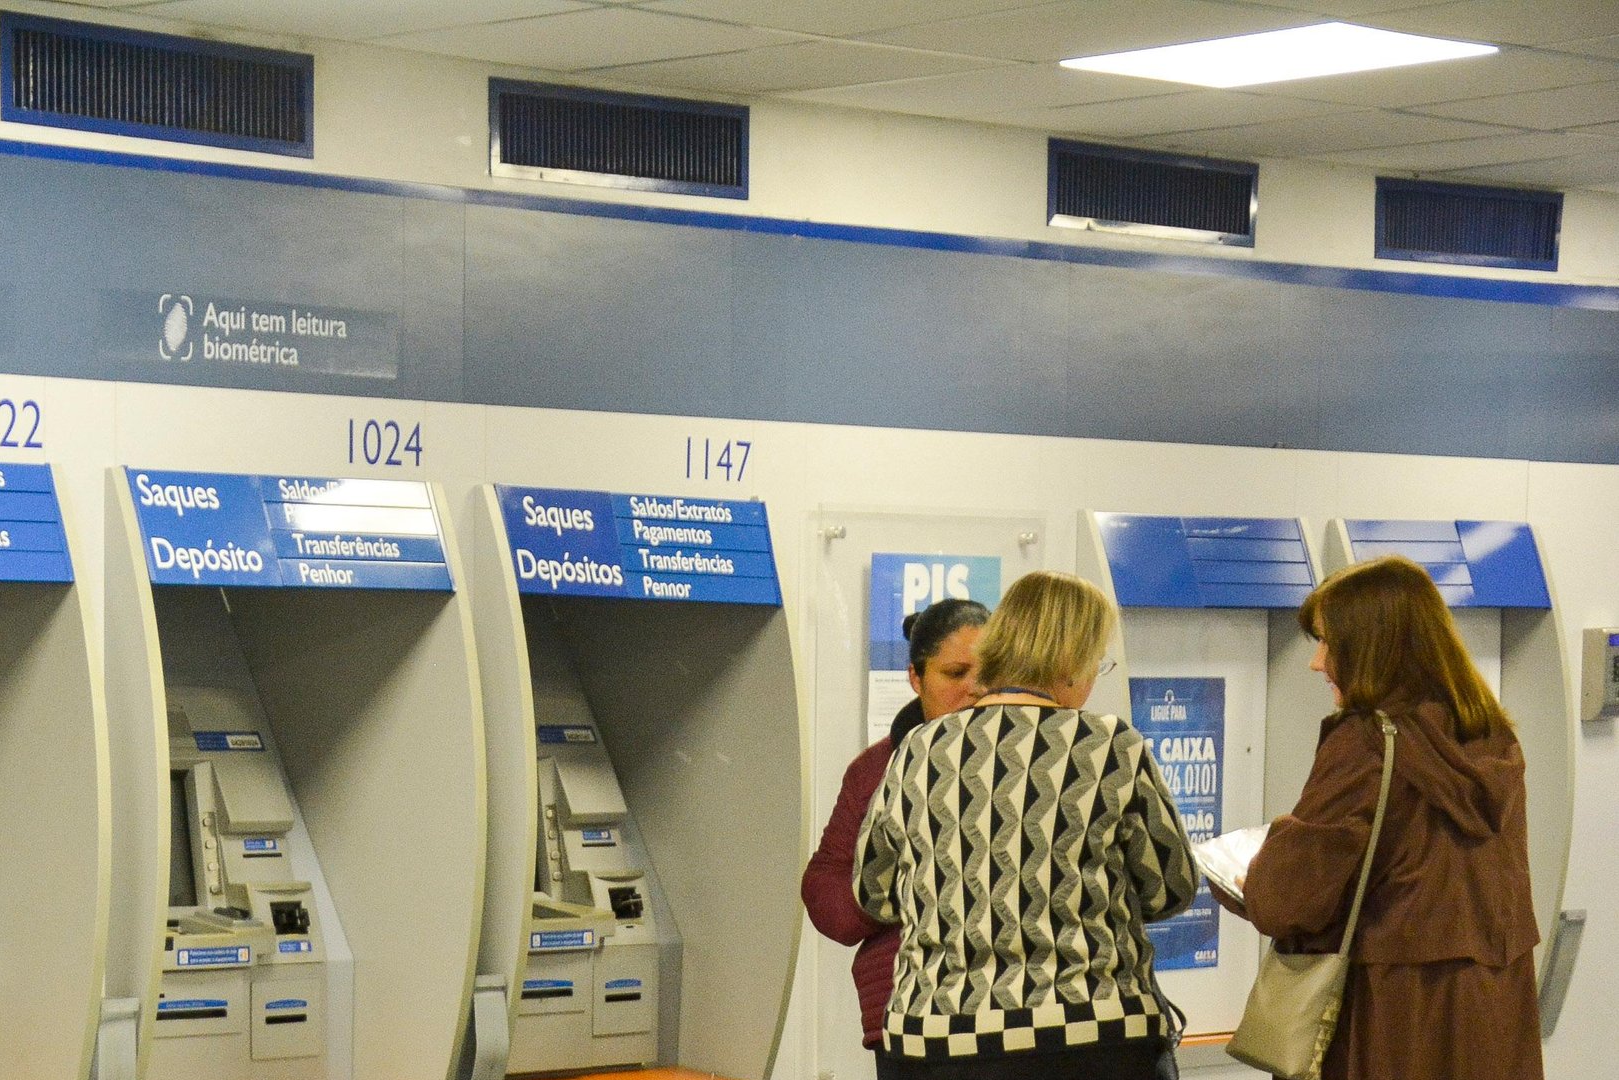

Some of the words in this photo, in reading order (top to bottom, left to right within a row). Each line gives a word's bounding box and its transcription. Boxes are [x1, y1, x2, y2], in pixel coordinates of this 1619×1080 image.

[203, 302, 245, 336] Aqui
[251, 312, 285, 333] tem
[292, 309, 347, 338] leitura
[204, 333, 299, 365] biométrica
[347, 418, 423, 468] 1024
[684, 436, 752, 483] 1147
[136, 473, 220, 517] Saques
[629, 496, 733, 523] Saldos/Extratos
[522, 495, 595, 537] Saques
[633, 519, 713, 546] Pagamentos
[150, 536, 263, 580] Depósito
[291, 532, 400, 558] Transferências
[638, 548, 735, 575] Transferências
[298, 562, 354, 585] Penhor
[516, 548, 624, 590] Depósitos
[902, 562, 970, 617] PIS
[1159, 737, 1217, 763] CAIXA
[1184, 763, 1217, 796] 0101
